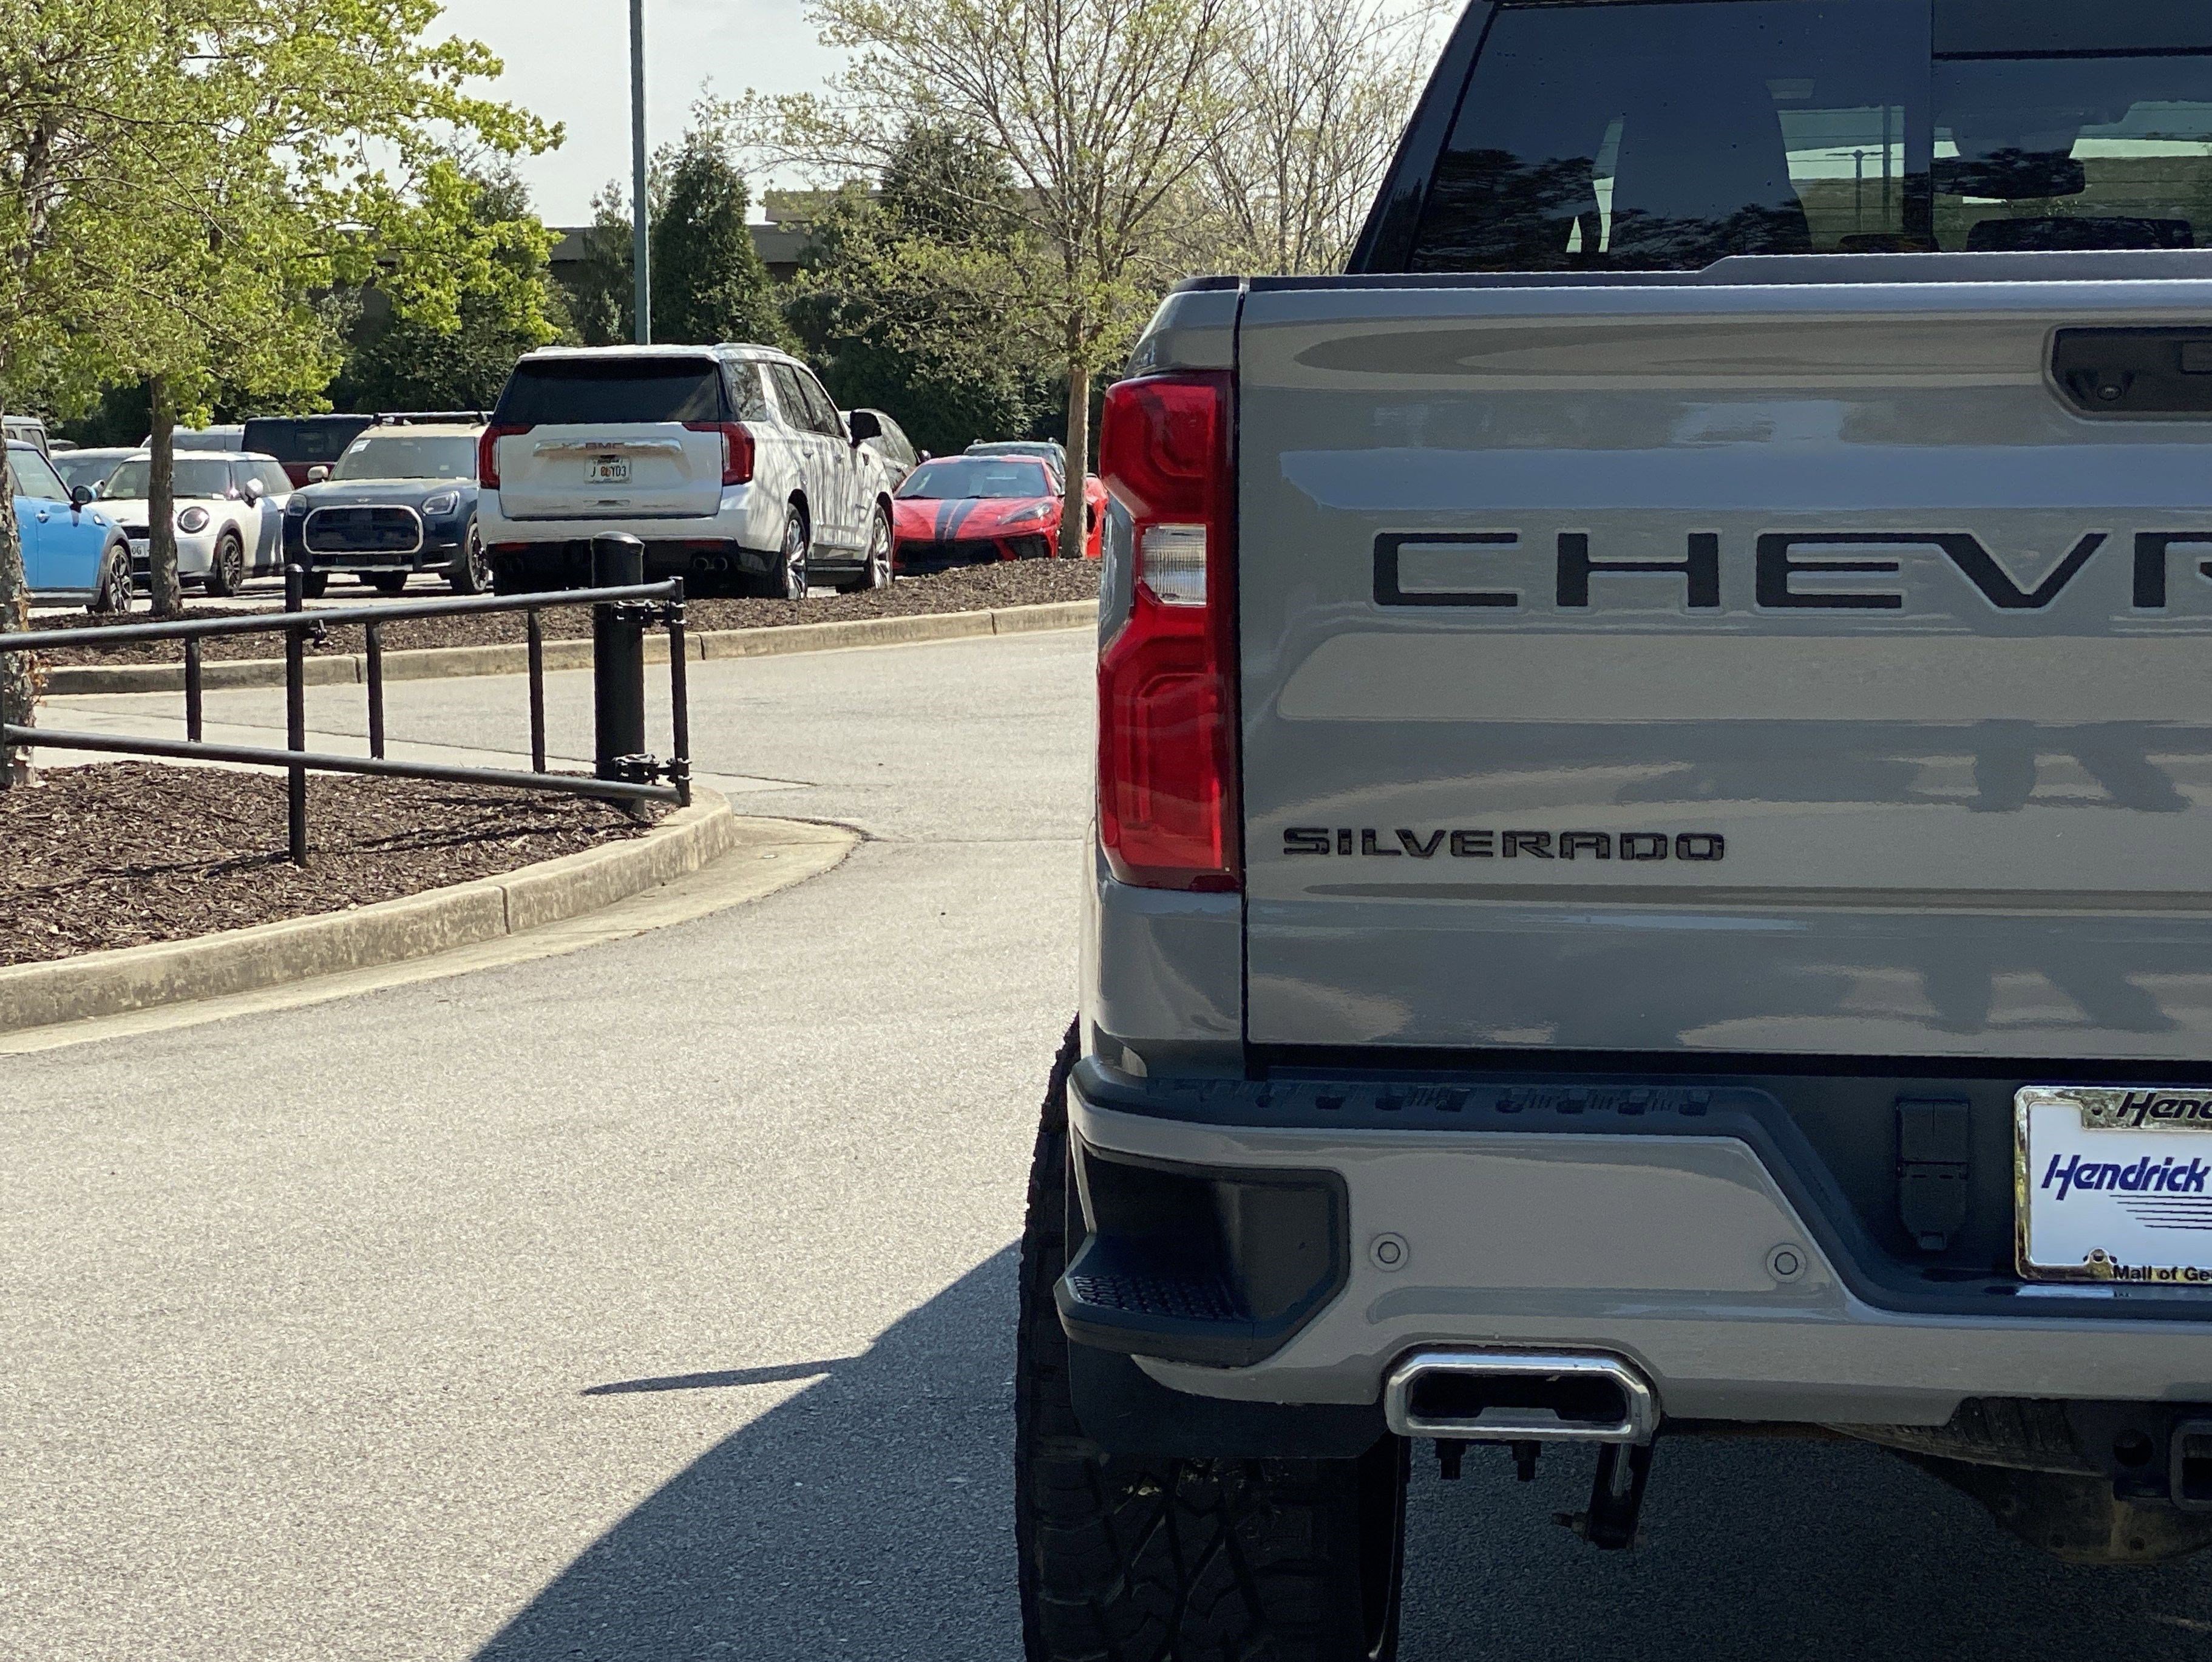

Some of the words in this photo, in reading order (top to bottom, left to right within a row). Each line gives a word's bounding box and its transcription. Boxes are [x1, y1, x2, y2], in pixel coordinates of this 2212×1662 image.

[1283, 827, 1725, 861] SILVERADO
[2041, 1154, 2211, 1201] Hendrick
[2113, 1264, 2153, 1281] Mall
[2159, 1266, 2178, 1280] of
[2183, 1266, 2212, 1281] Ge
